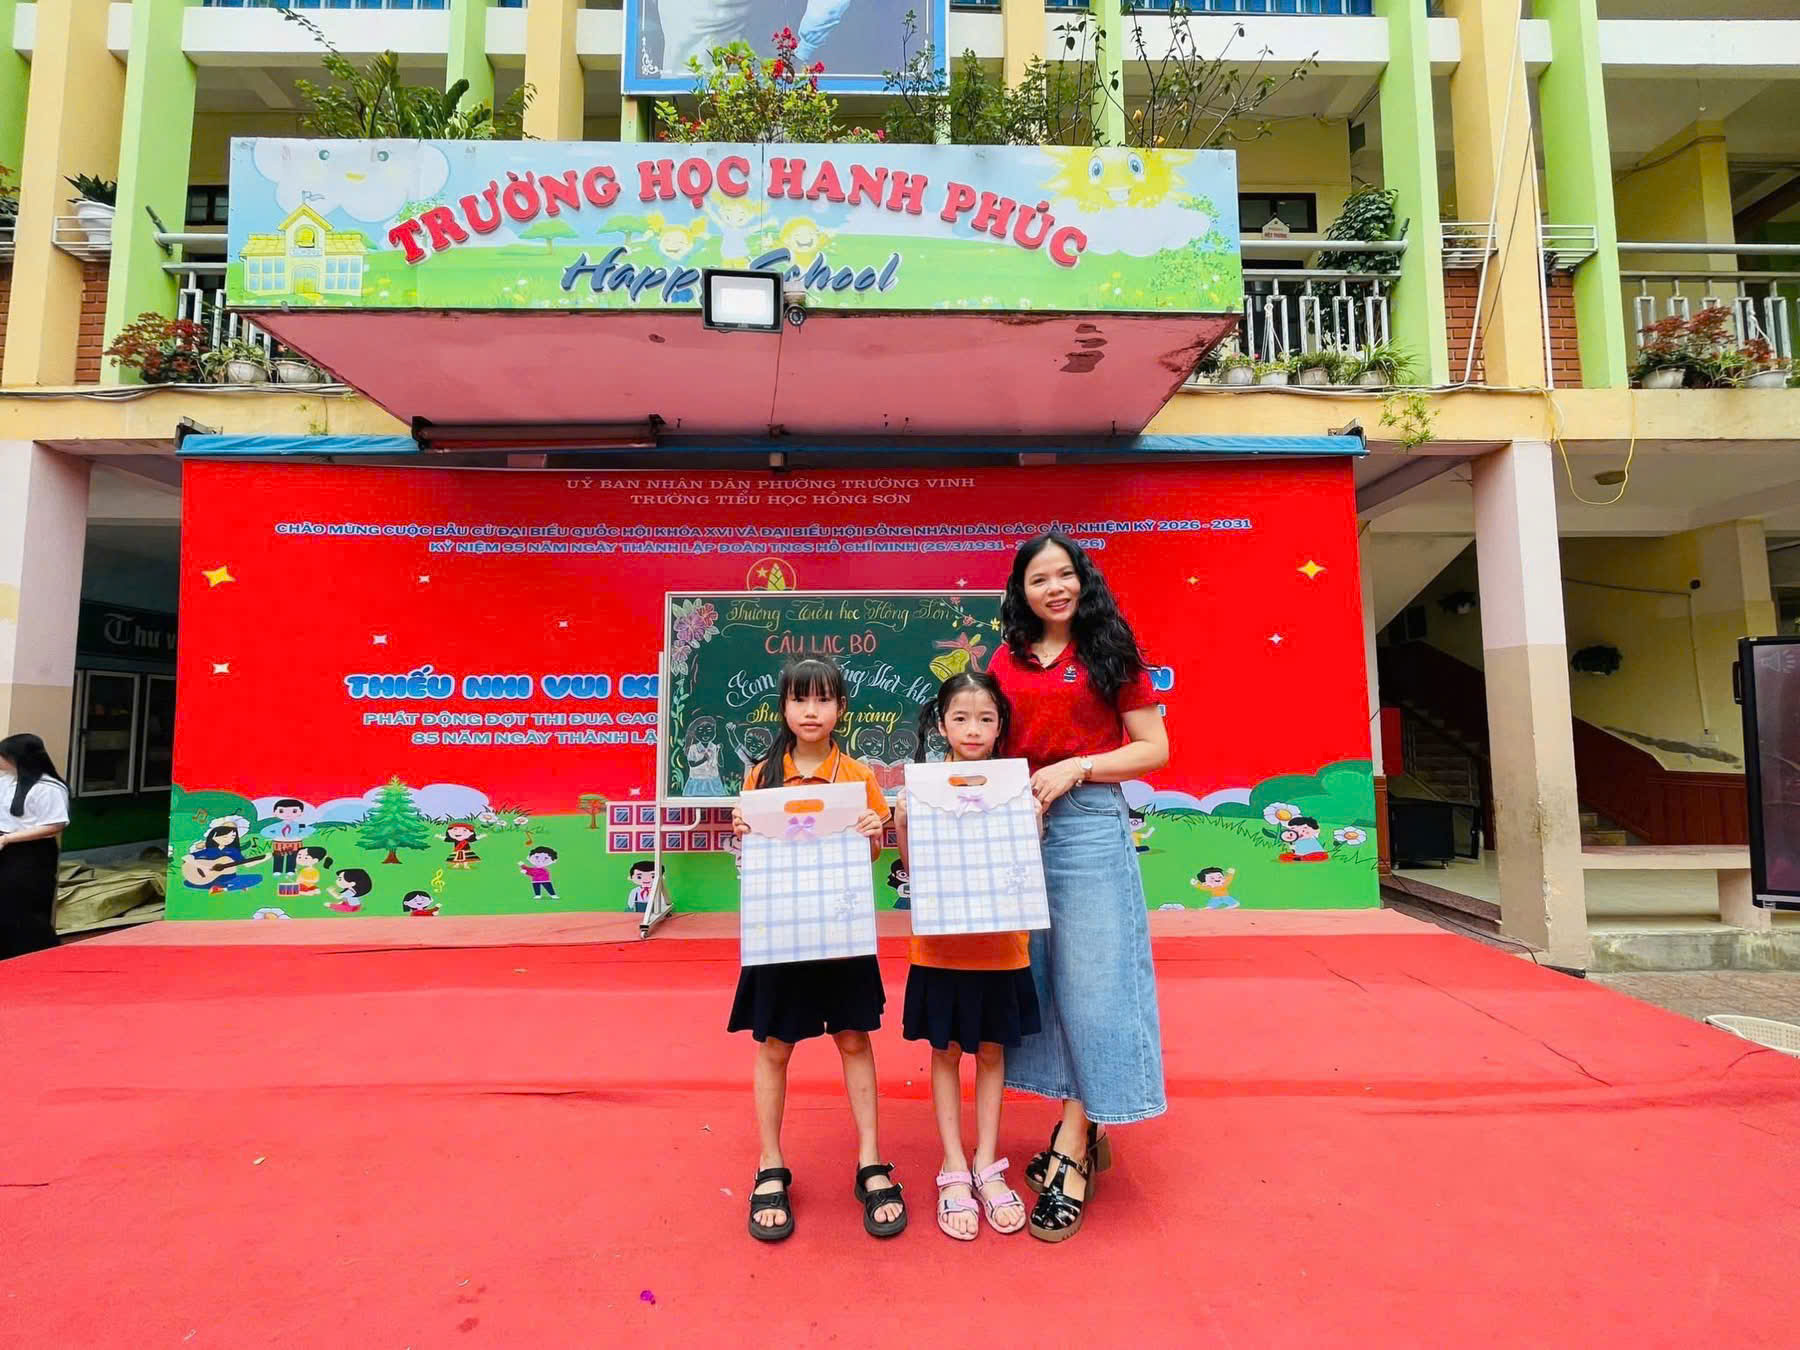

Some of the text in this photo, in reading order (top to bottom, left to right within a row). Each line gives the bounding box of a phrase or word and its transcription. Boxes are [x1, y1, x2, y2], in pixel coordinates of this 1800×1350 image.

[388, 165, 622, 265] TRƯỜNG
[636, 155, 751, 209] HỌC
[940, 181, 1088, 268] PHÚC
[562, 246, 701, 302] Happ
[600, 479, 641, 489] BAN
[647, 477, 704, 489] NHÂN
[710, 477, 752, 489] DÂN
[758, 478, 836, 490] PHƯỜNG
[841, 476, 920, 489] TRƯỜNG
[926, 478, 976, 488] VINH
[630, 489, 912, 507] TRƯỜNG TIỂU HỌC HỒNG SƠN
[275, 521, 327, 536] CHÀO
[327, 523, 381, 537] MỪNG
[383, 523, 431, 538] CUỘC
[496, 525, 528, 539] ĐẠI
[572, 523, 620, 538] QUỐC
[622, 525, 652, 538] HỘI
[655, 524, 702, 537] KHÓA
[704, 526, 733, 537] XVI
[735, 525, 758, 537] VÀ
[760, 527, 790, 538] ĐẠI
[833, 525, 861, 539] HỘI
[864, 522, 912, 537] ĐỒNG
[914, 524, 965, 537] NHÂN
[965, 523, 999, 536] DÂN
[1001, 521, 1037, 535] CÁC
[1077, 520, 1131, 534] NHIỆM
[1158, 519, 1201, 531] 2026
[1210, 518, 1252, 530] 2031
[456, 540, 500, 554] NIỆM
[502, 542, 525, 553] 95
[527, 540, 568, 553] NĂM
[571, 540, 617, 553] NGÀY
[621, 541, 679, 553] THÀNH
[683, 542, 716, 555] LẬP
[719, 540, 767, 553] ĐOÀN
[769, 542, 814, 553] TNCS
[816, 539, 842, 553] HỒ
[844, 540, 873, 553] CHÍ
[874, 541, 917, 553] MINH
[765, 629, 805, 654] CÂU
[849, 629, 877, 657] BỘ
[343, 664, 455, 700] THIẾU
[462, 674, 534, 700] NHI
[542, 674, 613, 699] VUI
[363, 710, 658, 727] PHÁT ĐỘNG ĐỢT THI ĐUA CAO
[411, 728, 658, 745] 85 NĂM NGÀY THÀNH LẬ
